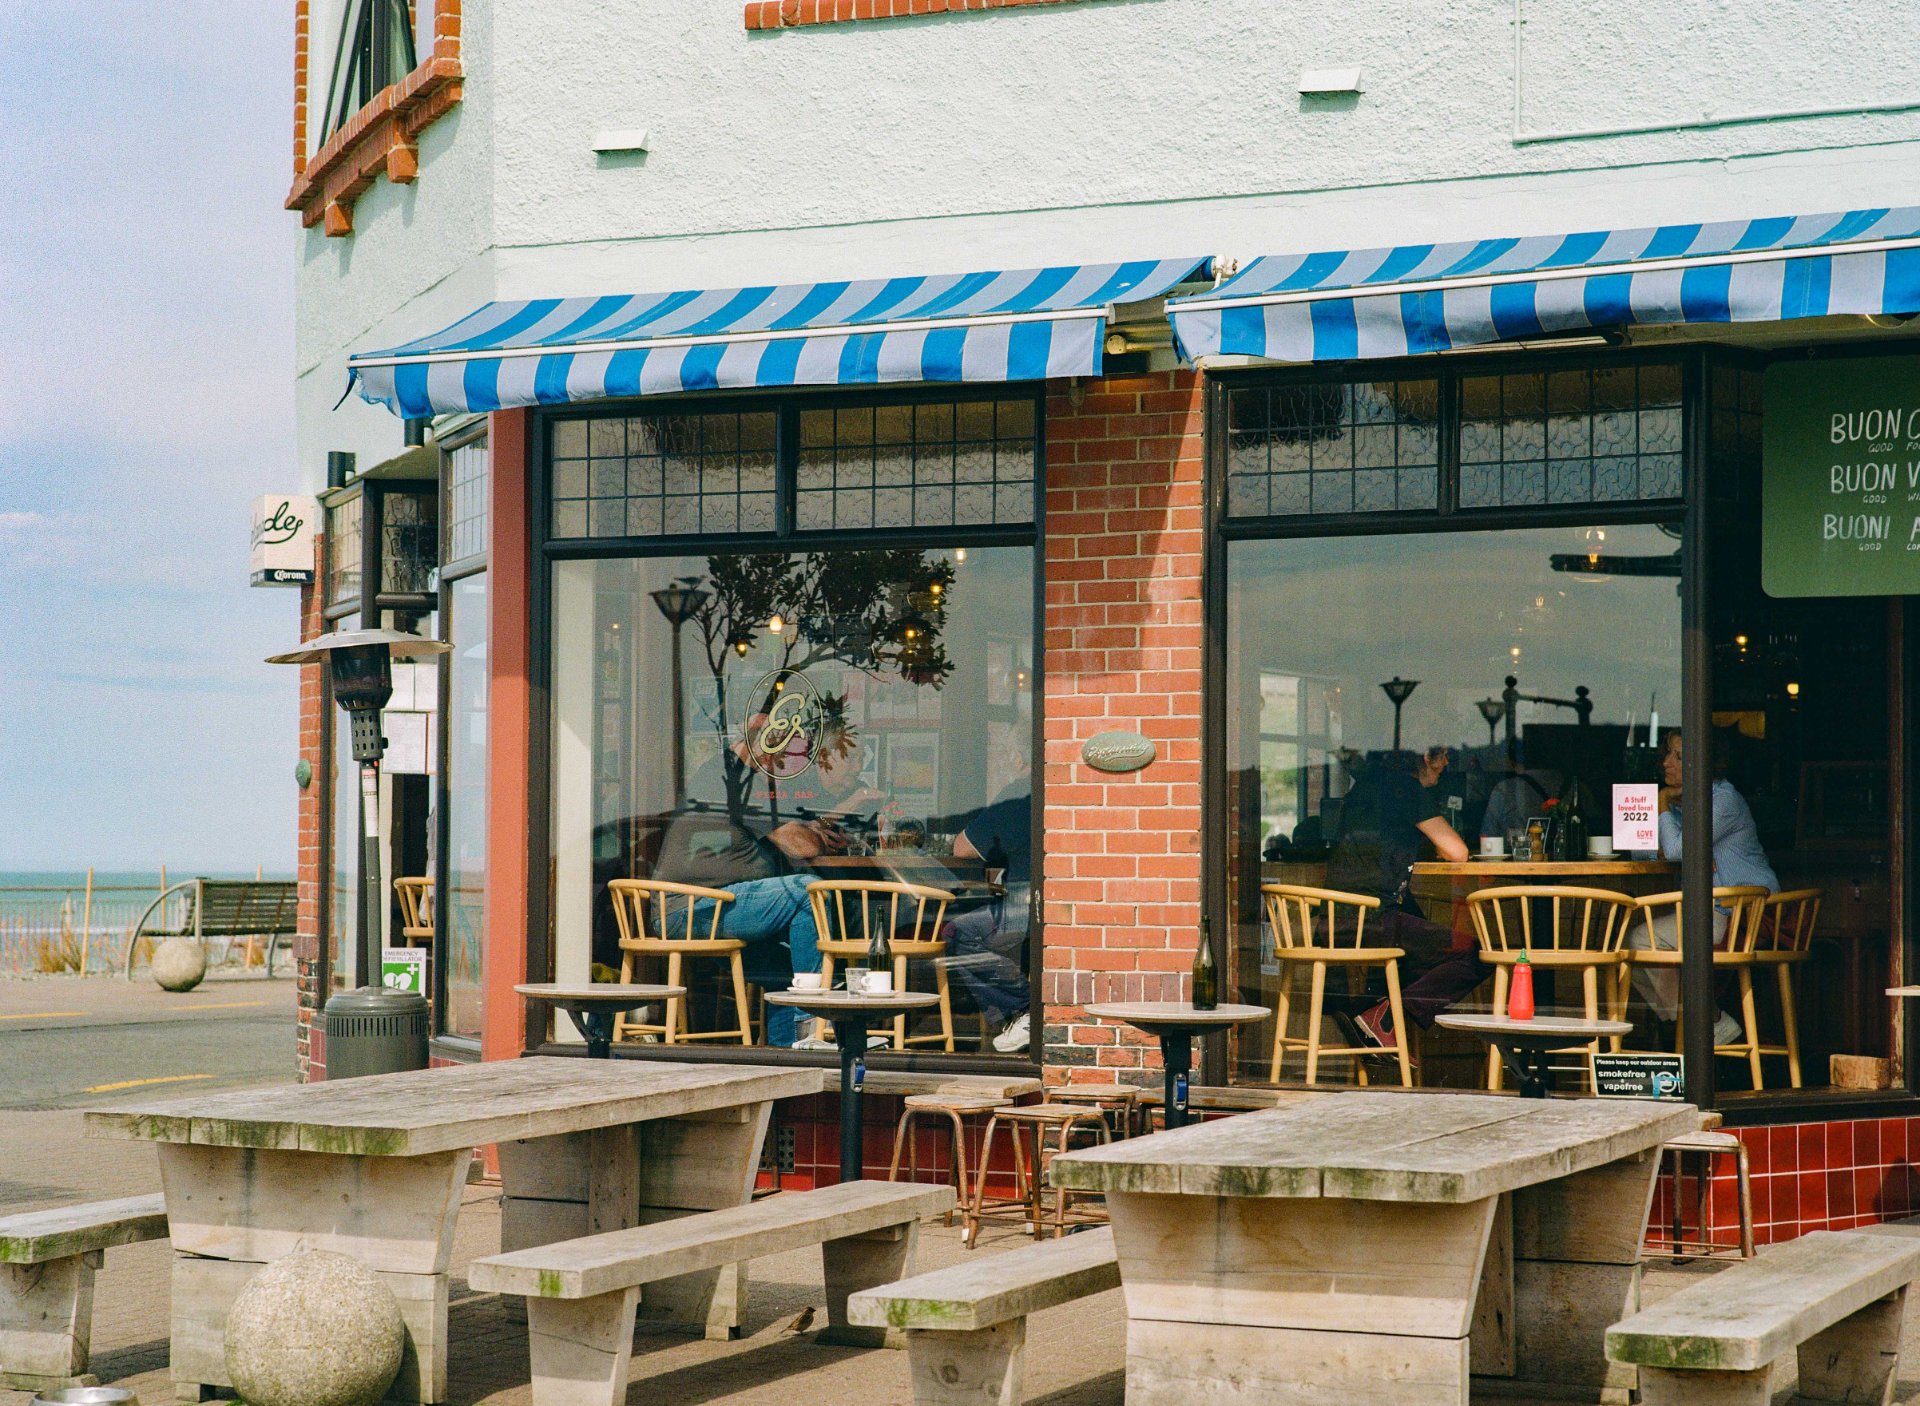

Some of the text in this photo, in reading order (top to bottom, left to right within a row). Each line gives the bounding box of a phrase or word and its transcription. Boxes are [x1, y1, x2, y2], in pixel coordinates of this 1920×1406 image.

[1830, 408, 1902, 444] BUON
[1868, 442, 1894, 453] GOOD
[1830, 463, 1897, 494] BUON
[1862, 494, 1887, 504] GOOD
[1823, 513, 1891, 540] BUONI
[1858, 542, 1882, 551] GOOD
[274, 569, 307, 581] Corona
[1623, 812, 1649, 822] 2022
[1598, 1070, 1647, 1079] smokefree
[1603, 1083, 1644, 1092] vapefree
